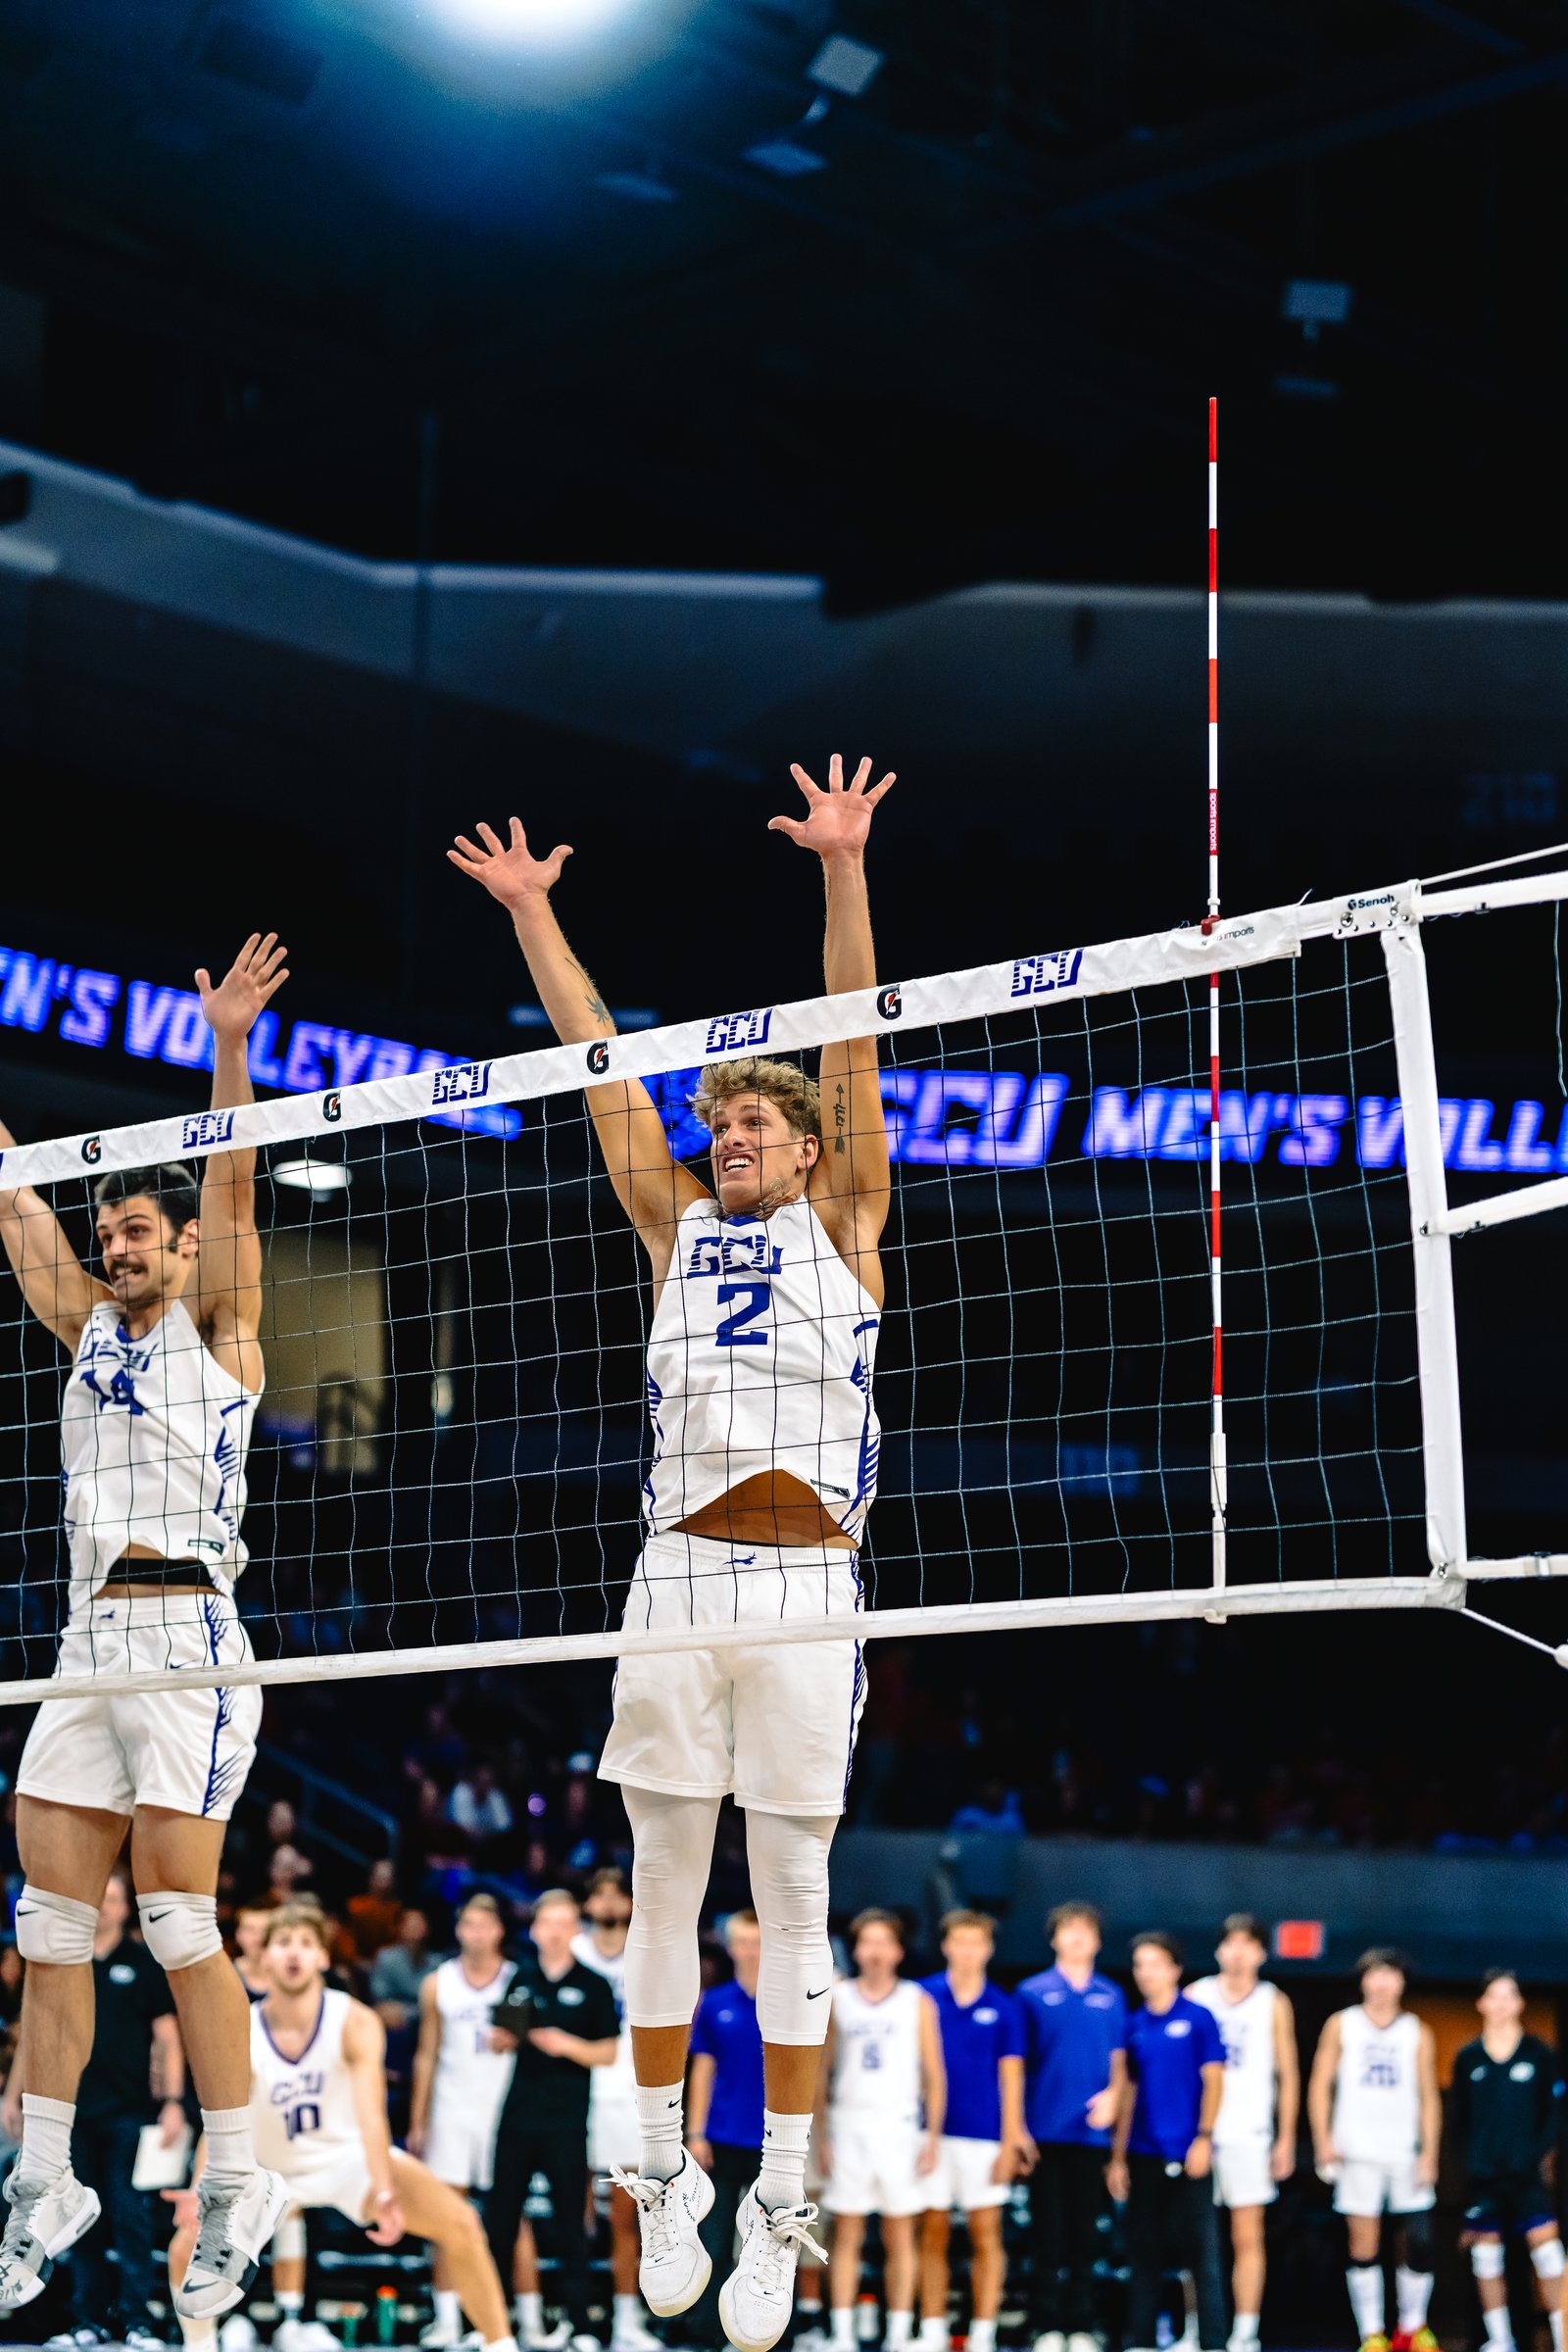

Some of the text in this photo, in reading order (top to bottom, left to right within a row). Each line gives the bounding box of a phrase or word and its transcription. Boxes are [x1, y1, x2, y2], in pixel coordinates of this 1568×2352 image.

[1357, 893, 1396, 909] Senoh
[1010, 948, 1084, 998] GCU
[0, 946, 121, 1048] N'S
[705, 1007, 774, 1054] GCU
[431, 1061, 493, 1105] GCU
[182, 1110, 235, 1149] GCU
[1080, 1086, 1348, 1166] MEN'S
[687, 1234, 785, 1280] GCU
[715, 1281, 771, 1347] 2
[282, 2103, 321, 2140] 10
